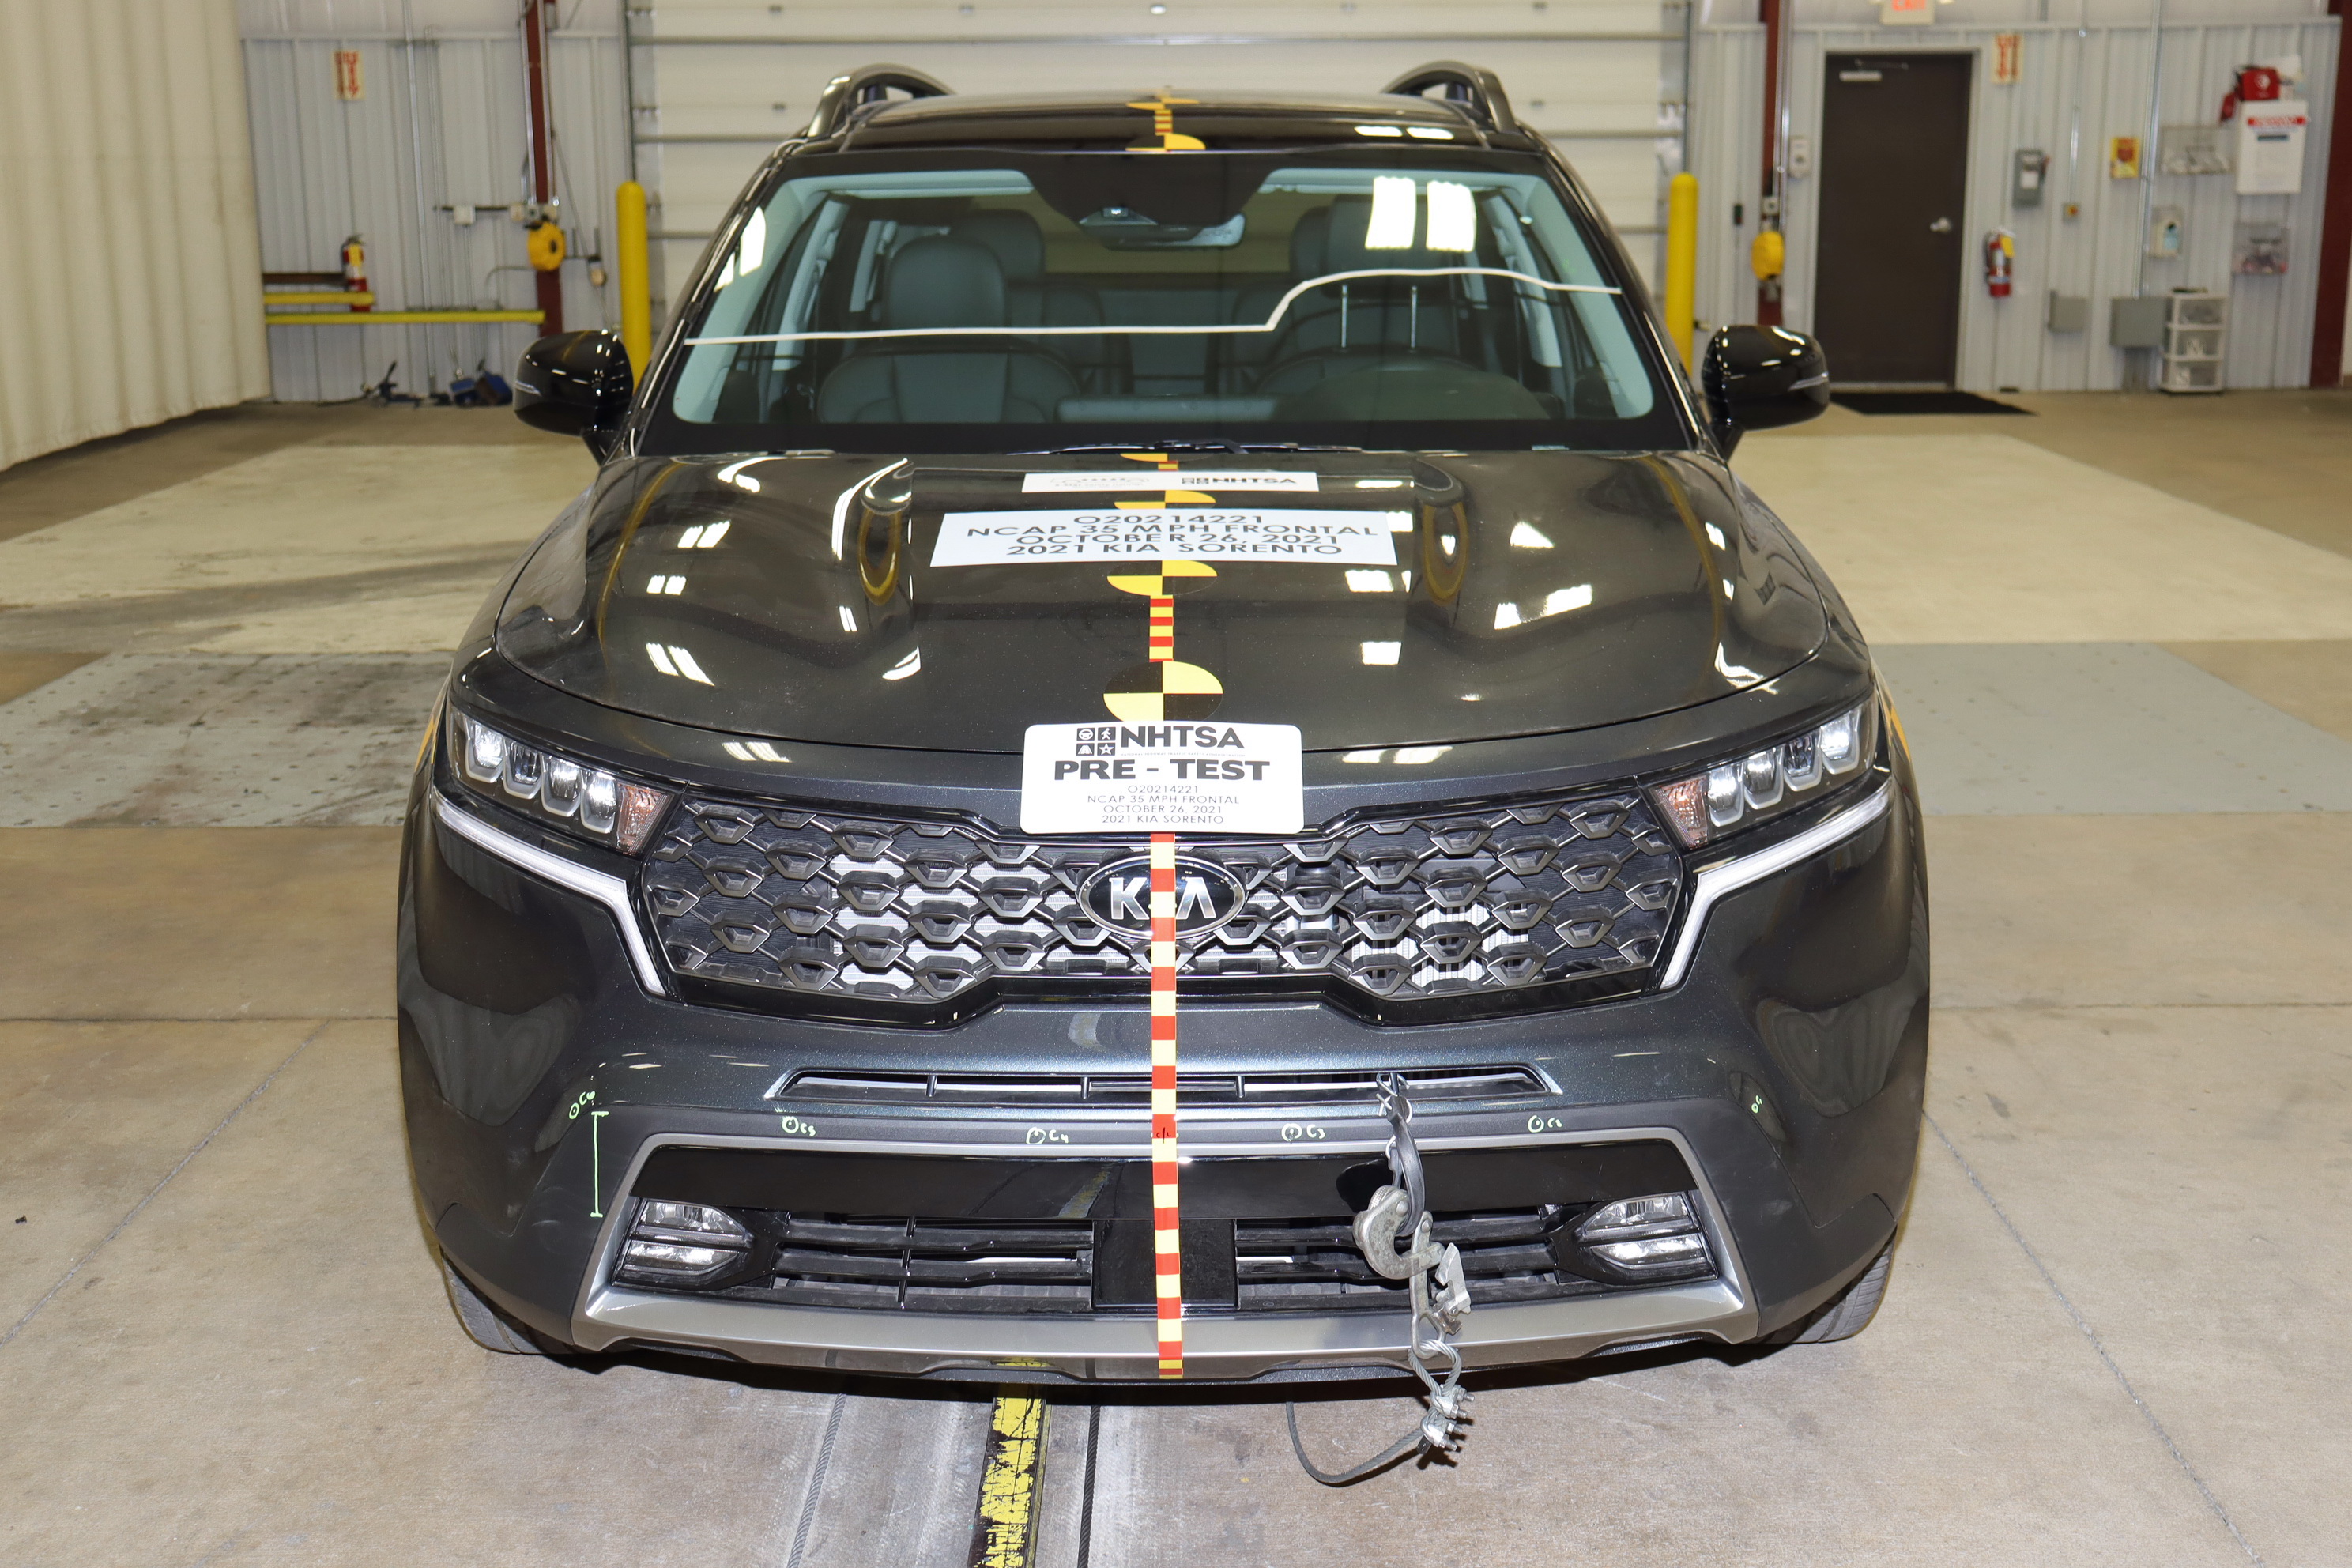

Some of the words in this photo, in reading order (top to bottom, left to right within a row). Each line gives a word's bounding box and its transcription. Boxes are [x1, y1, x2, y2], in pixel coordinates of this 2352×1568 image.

[967, 526, 1067, 537] NCAP
[1080, 525, 1119, 533] 35
[1225, 525, 1378, 536] FRONTAL
[1016, 534, 1186, 544] OCTOBER
[1200, 534, 1247, 544] 26,
[1262, 534, 1338, 545] 2021
[1006, 545, 1084, 556] 2021
[1103, 544, 1161, 553] KIA
[1178, 544, 1342, 555] SORENTO
[1121, 726, 1245, 748] NHTSA
[1054, 760, 1136, 780] PRE
[1170, 759, 1270, 780] TEST
[1182, 795, 1240, 804] FRONTAL
[1103, 805, 1165, 813] OCTOBER
[1193, 805, 1222, 814] 2021
[1102, 815, 1131, 824] 2021
[1163, 815, 1224, 824] SORENTO
[1109, 877, 1217, 920] KA
